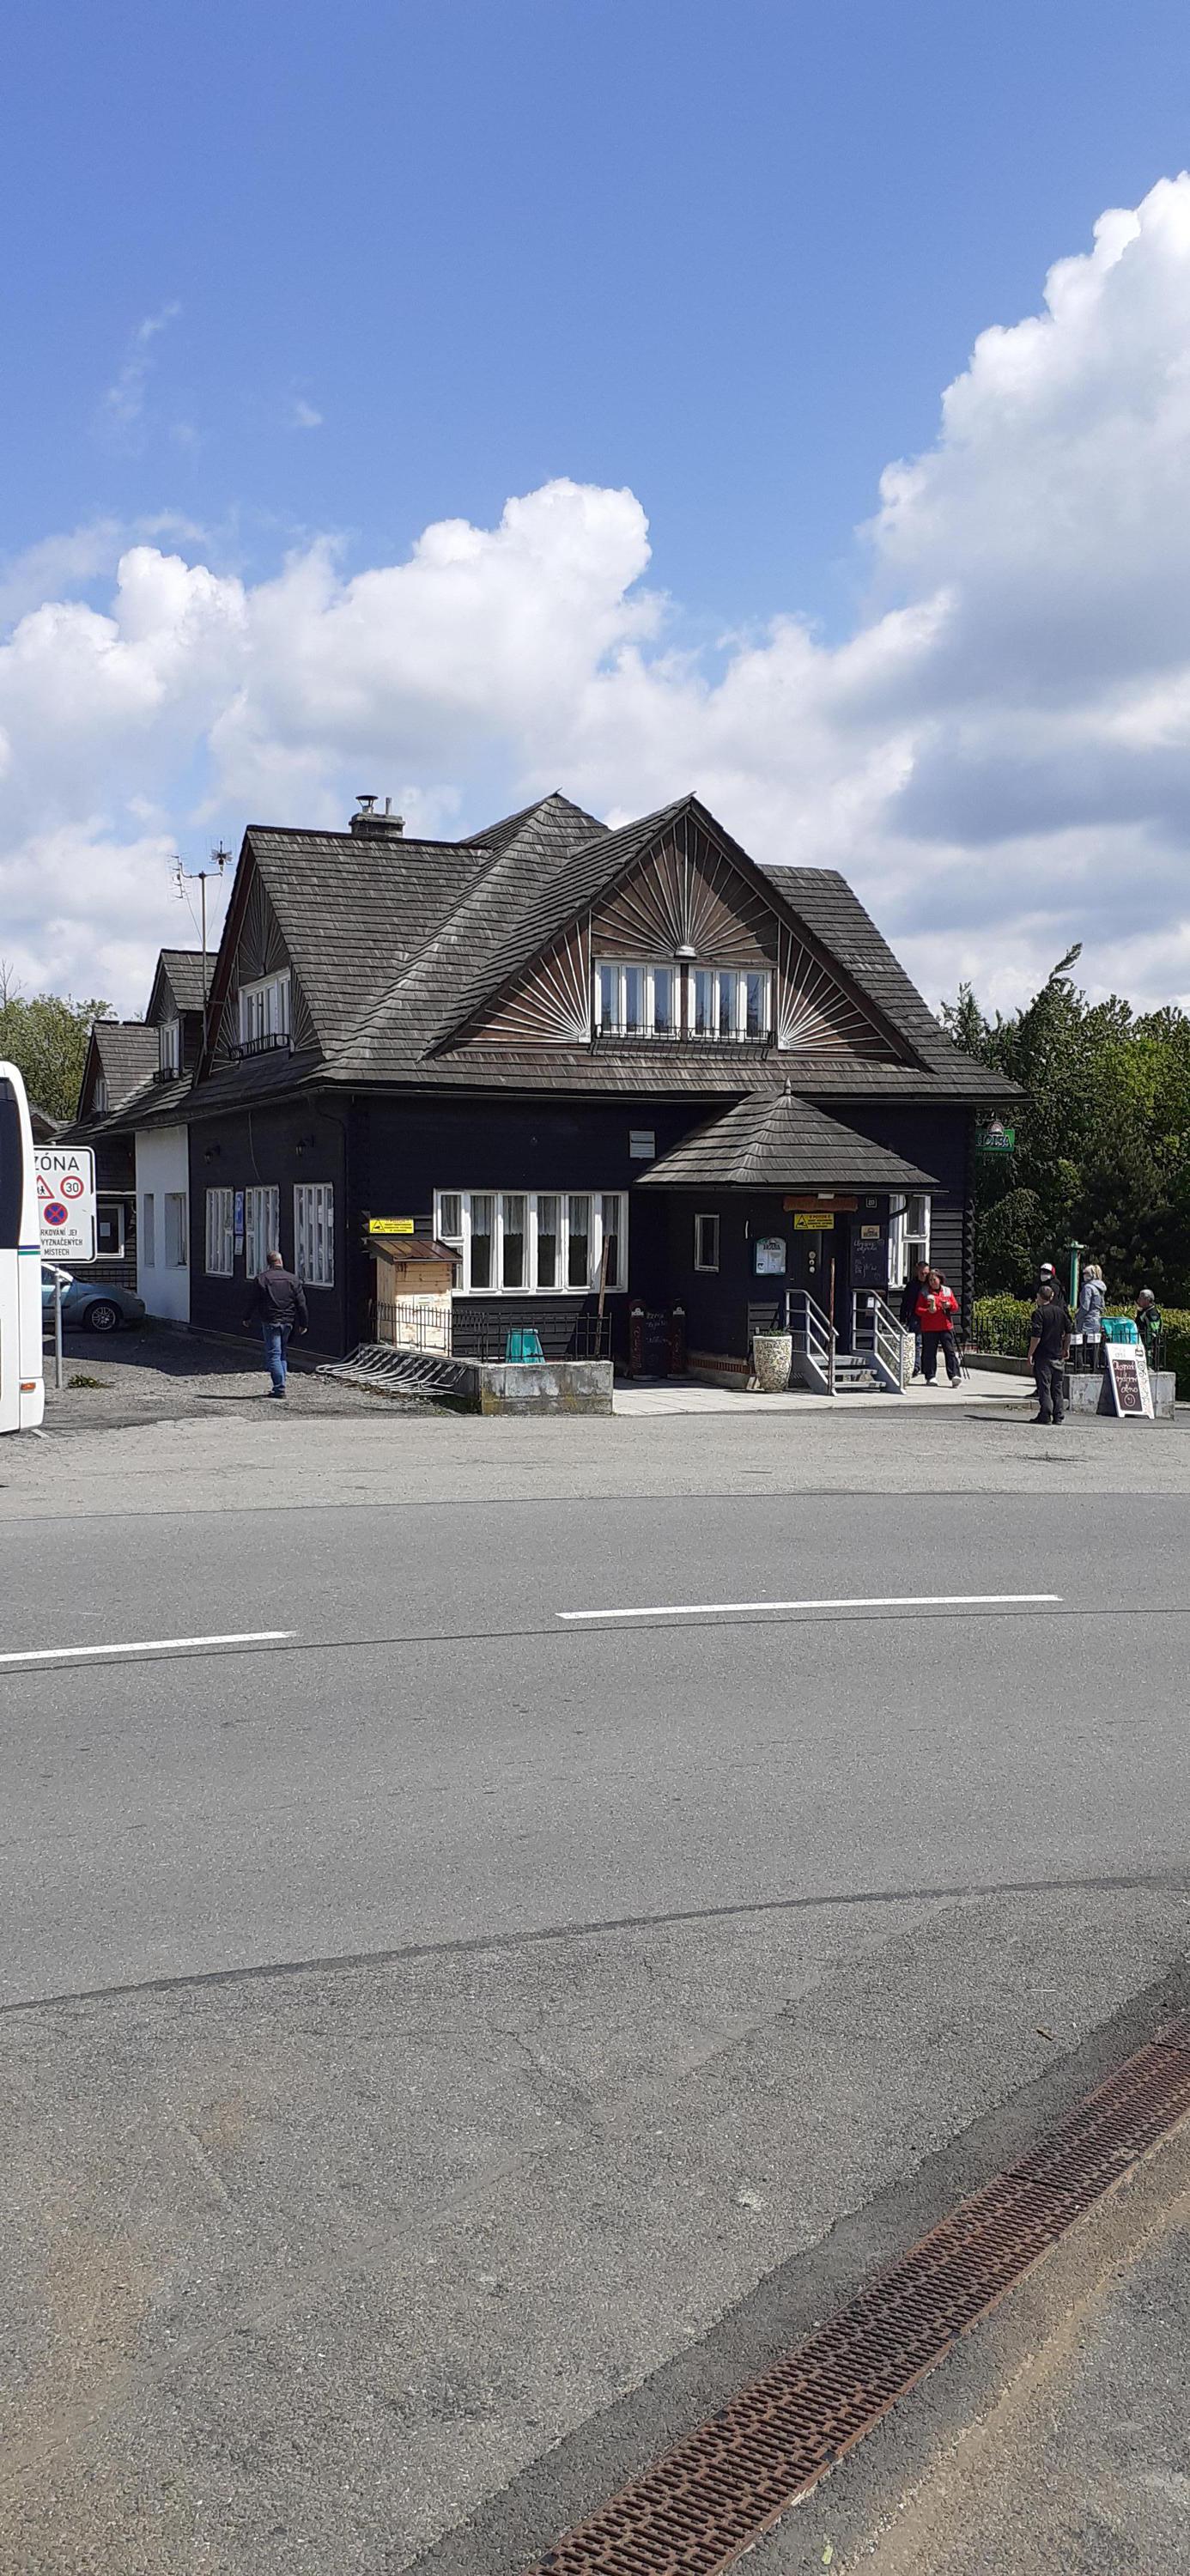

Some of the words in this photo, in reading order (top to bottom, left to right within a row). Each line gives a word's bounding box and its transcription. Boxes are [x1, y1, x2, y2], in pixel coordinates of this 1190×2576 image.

[65, 1182, 80, 1193] 30
[40, 1227, 66, 1236] RKOVÁNÍ
[40, 1237, 83, 1246] VYZNAČENÝCH
[44, 1247, 70, 1256] MÍSTECH
